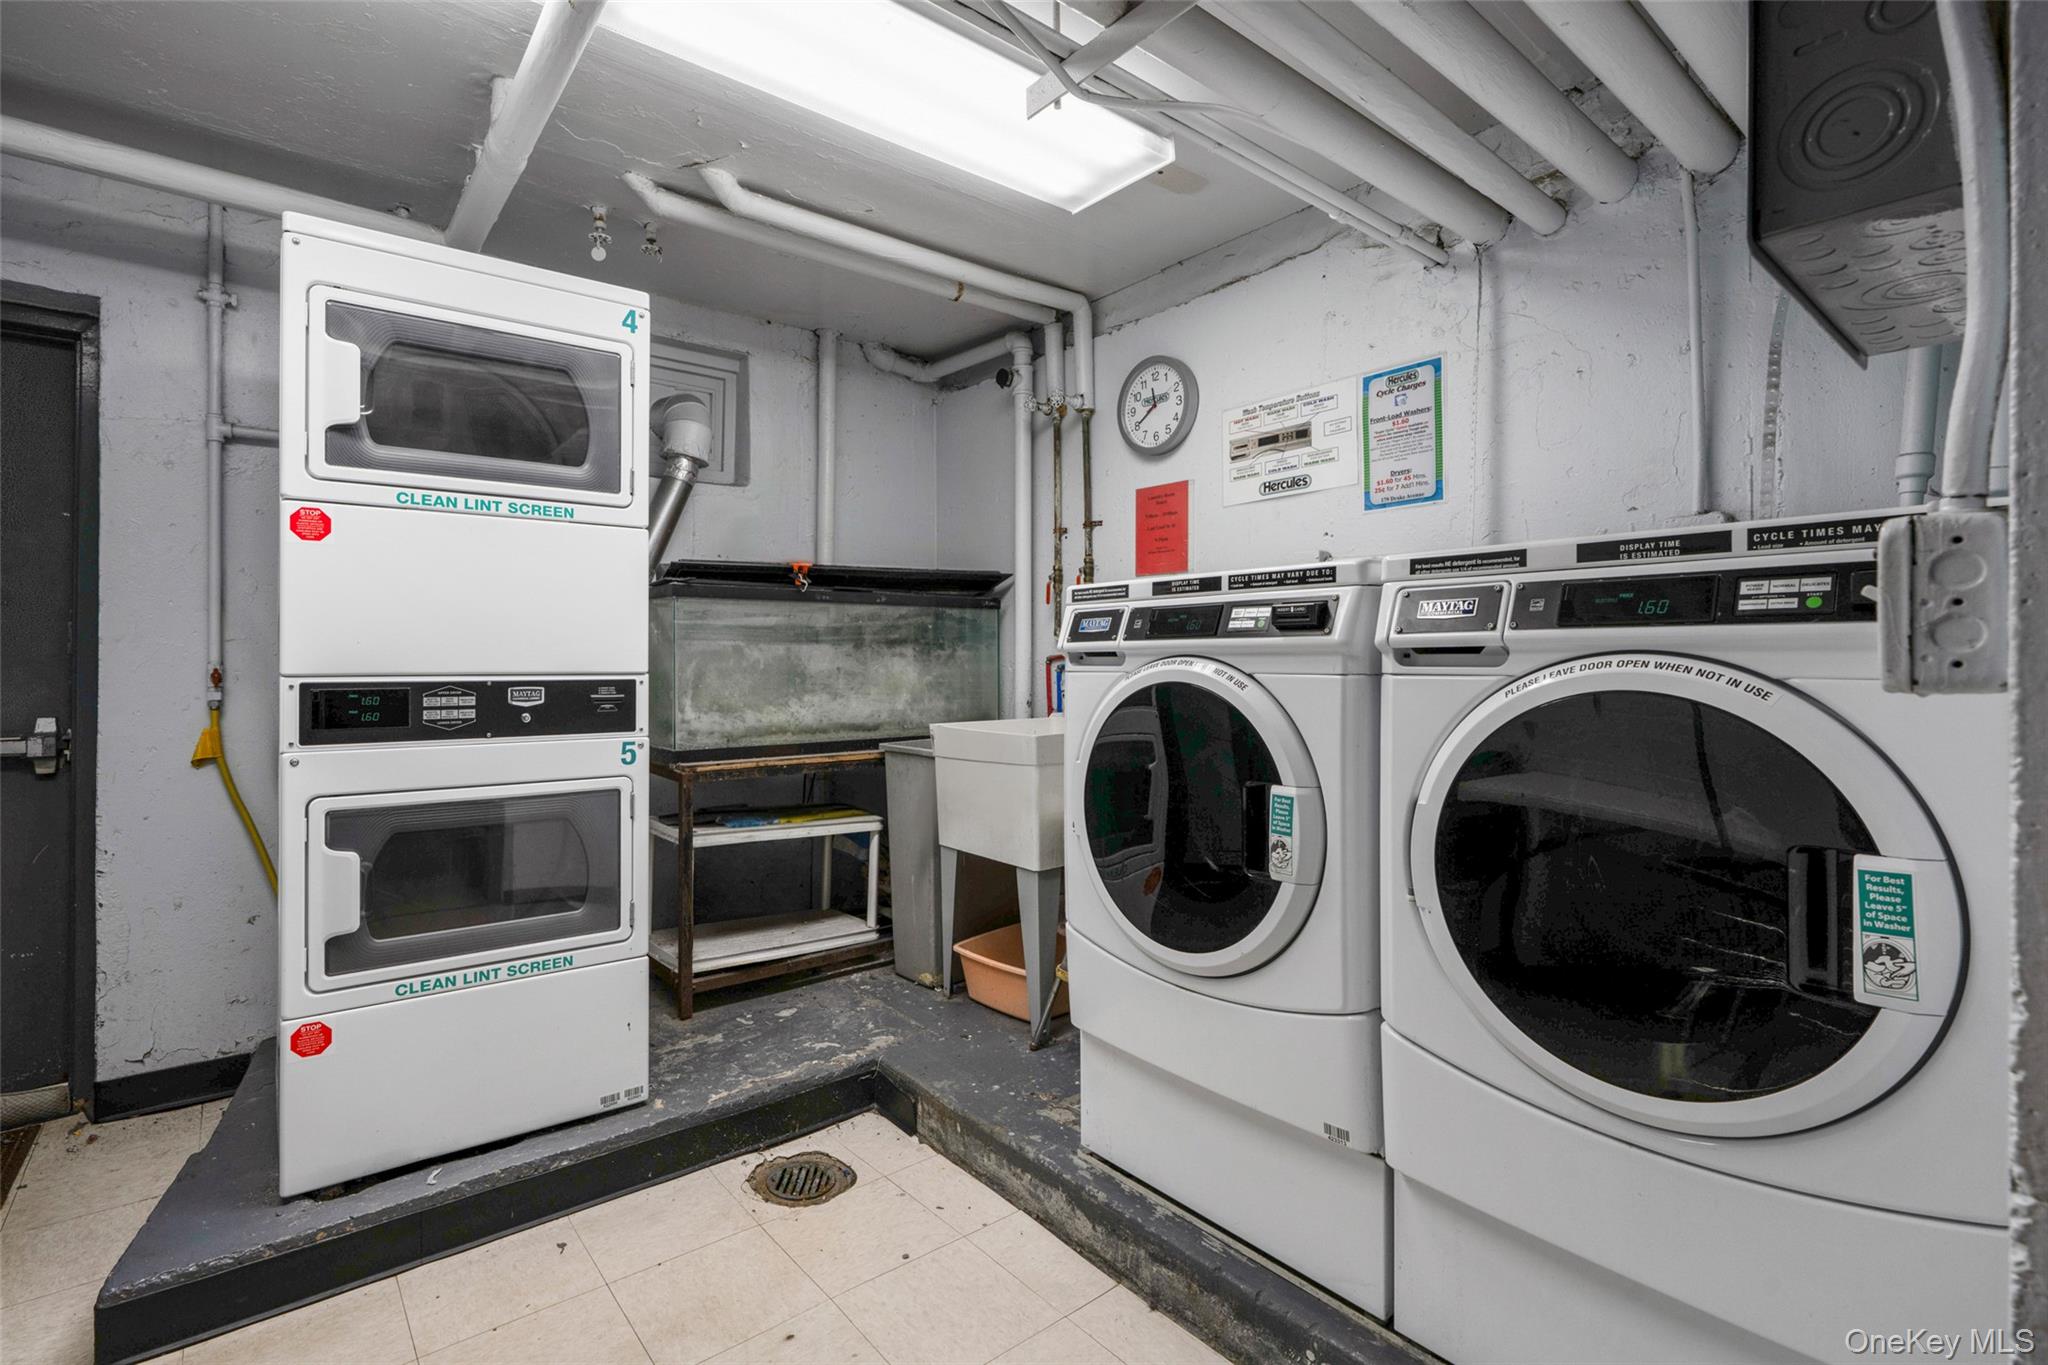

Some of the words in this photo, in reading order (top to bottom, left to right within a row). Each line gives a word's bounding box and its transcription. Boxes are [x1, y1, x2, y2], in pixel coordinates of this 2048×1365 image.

[621, 310, 638, 334] 4
[1152, 371, 1160, 382] 12
[1164, 372, 1168, 382] 1
[1388, 372, 1416, 386] Hercules
[1141, 380, 1147, 390] 11
[1173, 382, 1180, 392] 2
[1376, 388, 1395, 398] Cycle
[1397, 380, 1426, 392] Charges
[1134, 392, 1141, 402] 10
[1176, 395, 1182, 406] 3
[1259, 398, 1295, 411] Temperature
[1296, 391, 1320, 402] Buttons
[1130, 407, 1136, 417] 9
[1173, 412, 1179, 422] 4
[1370, 412, 1402, 424] Front-Load
[1135, 421, 1140, 432] 8
[1165, 424, 1172, 434] 5
[1142, 430, 1148, 440] 7
[1153, 431, 1160, 442] 6
[1263, 476, 1308, 493] Hercules
[396, 492, 458, 508] CLEAN
[464, 498, 502, 512] LINT
[508, 502, 575, 518] SCREEN
[1754, 531, 1795, 542] CYCLE
[1801, 526, 1844, 538] TIMES
[1852, 523, 1882, 534] MAY
[1620, 543, 1655, 551] DISPLAY
[1659, 540, 1681, 548] TIME
[1632, 549, 1680, 559] ESTIMATED
[1421, 600, 1474, 612] MAYTAG
[1213, 668, 1226, 678] NOT
[1226, 674, 1234, 682] IN
[1233, 678, 1248, 692] USE
[1504, 676, 1540, 699] PLEASE
[1579, 660, 1612, 672] DOOR
[1616, 660, 1650, 670] OPEN
[1652, 660, 1694, 675] WHEN
[1695, 668, 1726, 684] NOT
[1725, 675, 1743, 688] IN
[1744, 681, 1774, 702] USE
[620, 741, 637, 766] 5
[1864, 874, 1881, 882] For
[1883, 876, 1904, 886] Best
[1866, 883, 1904, 896] Results,
[1870, 892, 1902, 903] Please
[1864, 901, 1894, 912] Leave
[1878, 912, 1908, 922] Space
[1874, 920, 1911, 932] Washer
[395, 976, 457, 996] CLEAN
[464, 968, 501, 986] LINT
[507, 956, 574, 976] SCREEN
[300, 1024, 322, 1032] STOP
